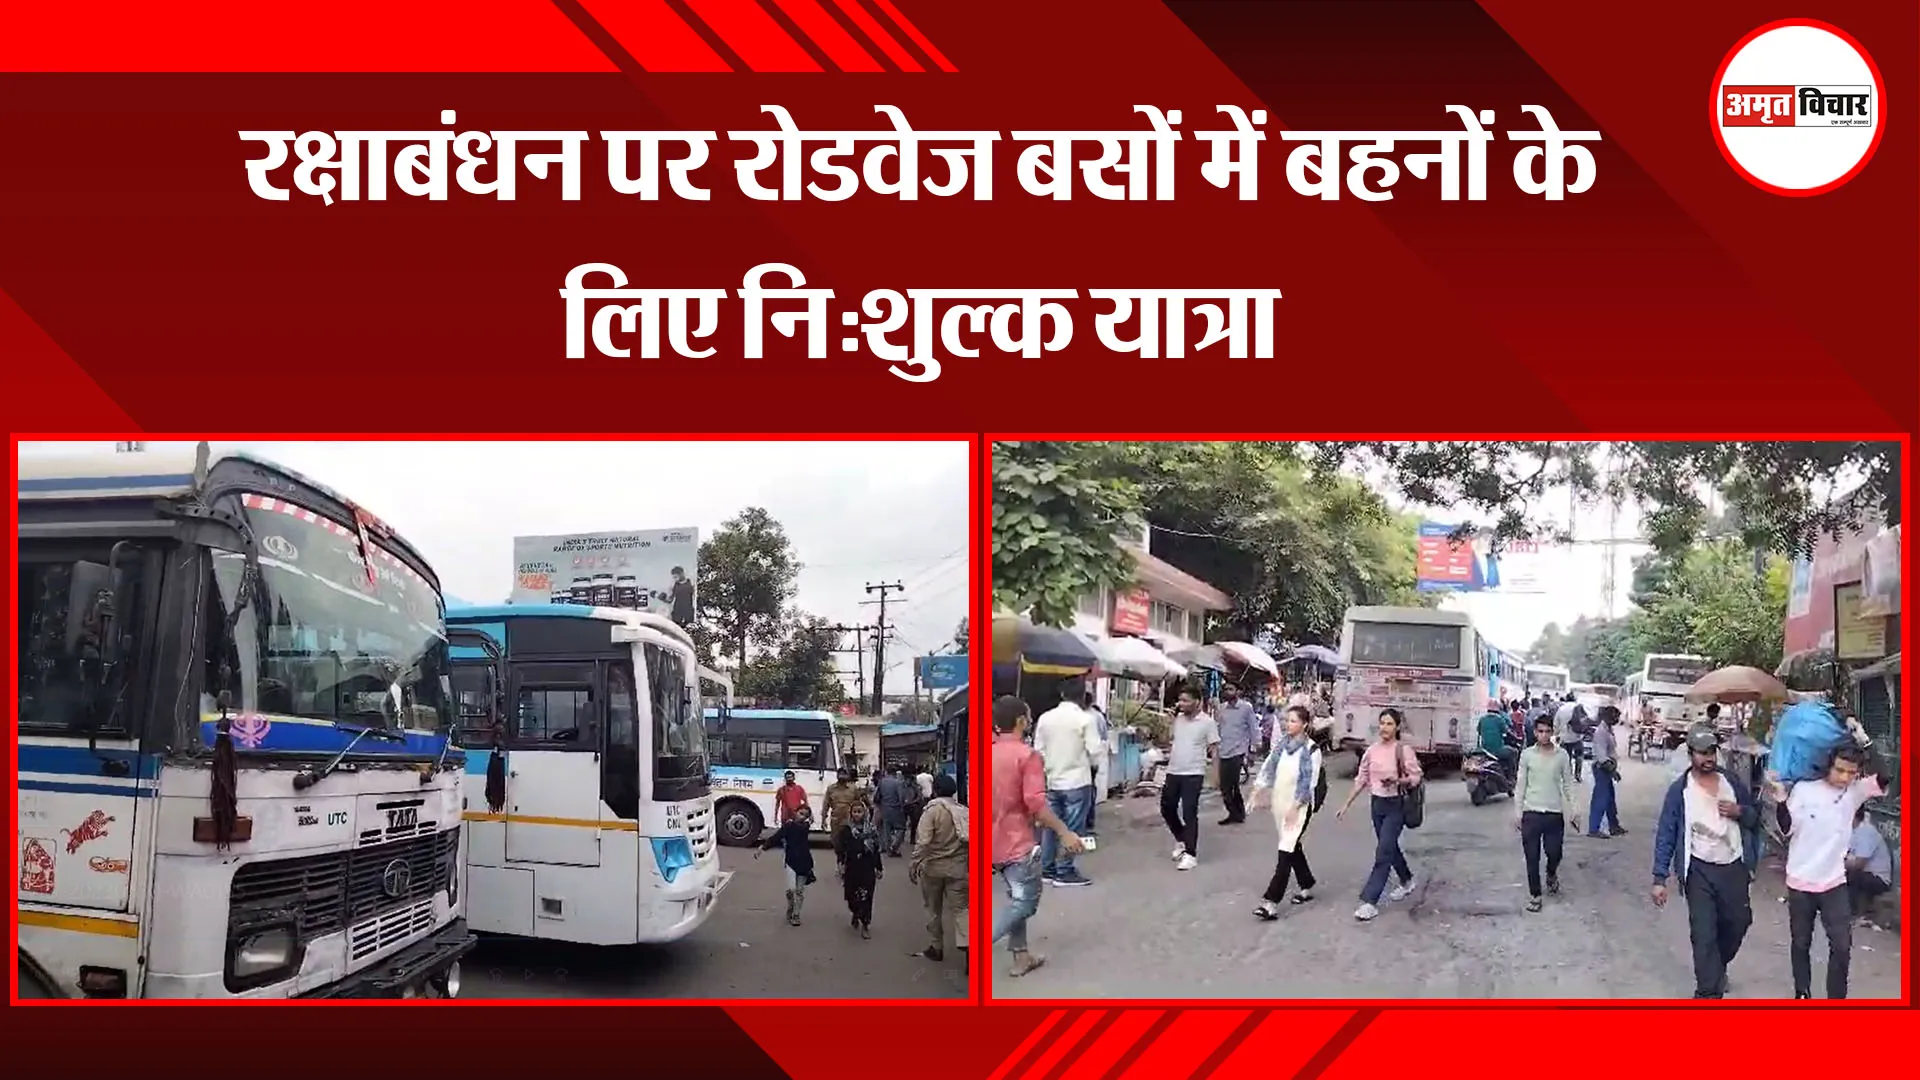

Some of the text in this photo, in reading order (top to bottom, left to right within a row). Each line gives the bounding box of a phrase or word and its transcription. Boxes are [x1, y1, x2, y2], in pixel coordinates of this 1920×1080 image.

[386, 808, 418, 827] TATA
[667, 805, 681, 816] UTC
[328, 811, 348, 826] UTC
